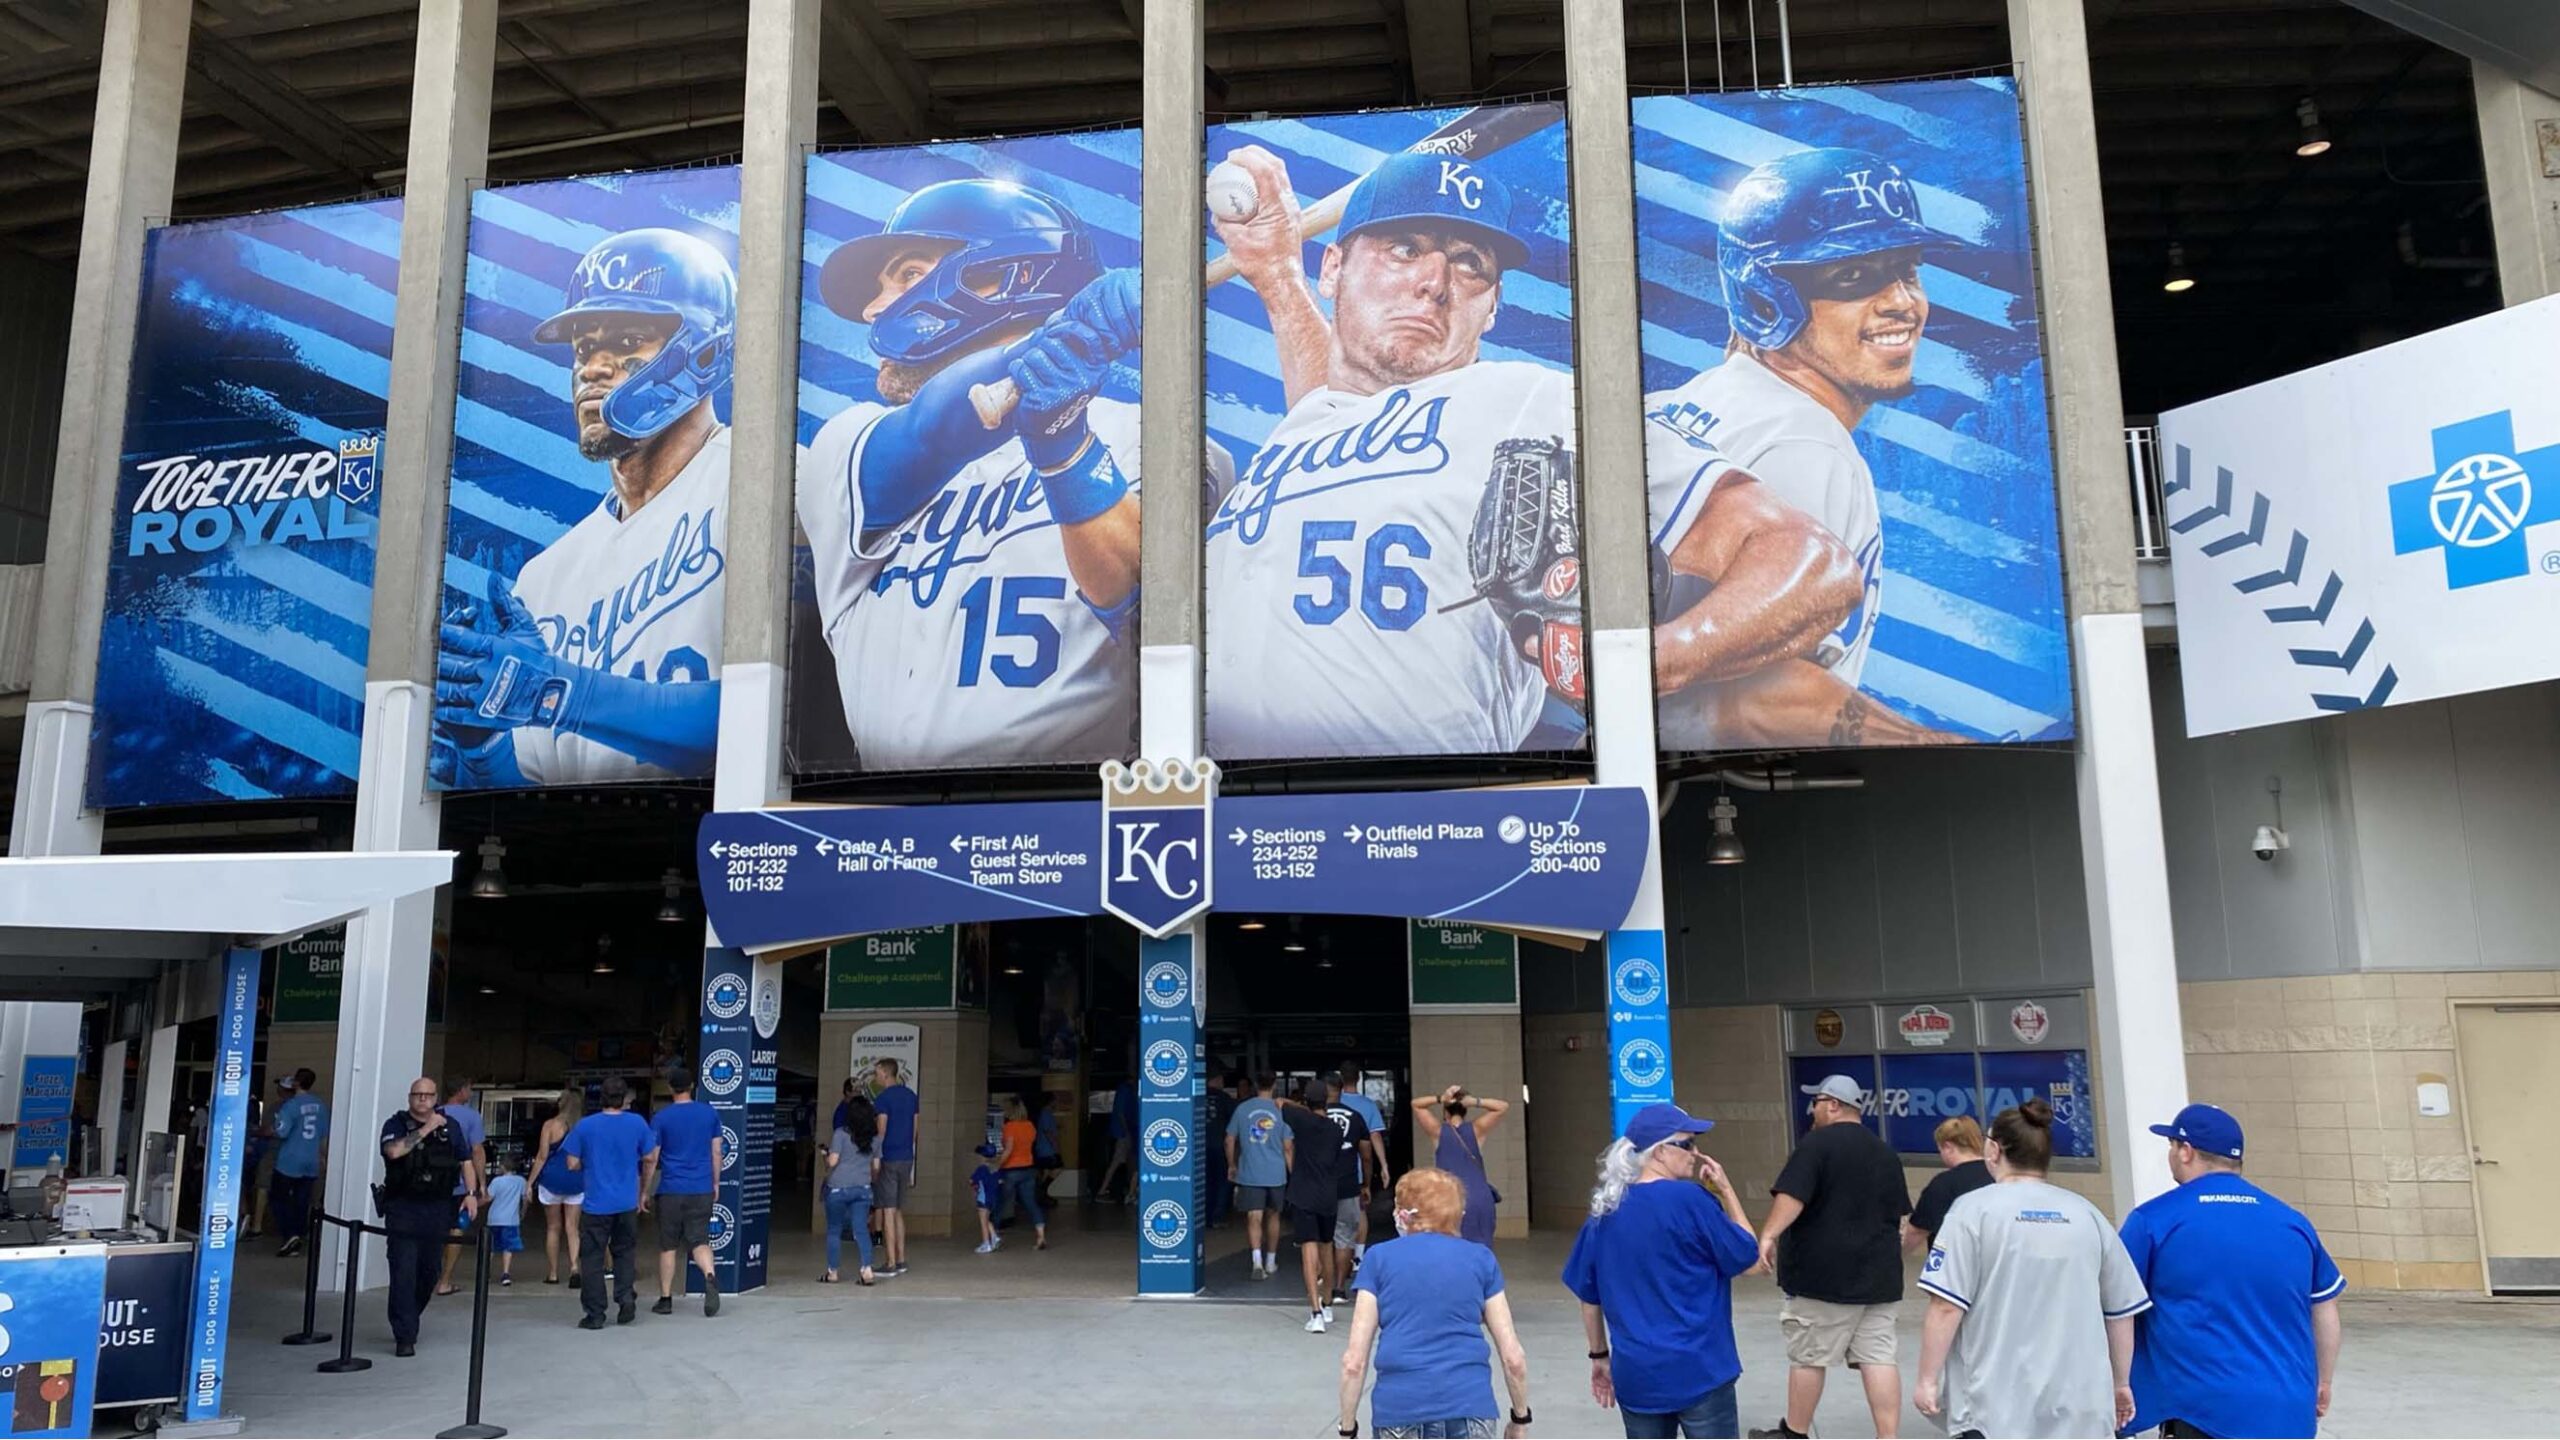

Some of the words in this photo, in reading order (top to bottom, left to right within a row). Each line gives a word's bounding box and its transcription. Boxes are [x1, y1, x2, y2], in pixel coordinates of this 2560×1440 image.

[1436, 160, 1484, 210] KC
[1845, 169, 1903, 217] KC
[582, 250, 629, 291] KC
[132, 450, 337, 514] TOGETHER
[342, 461, 371, 490] KC
[128, 495, 371, 557] ROYAL
[1293, 521, 1433, 632] 56
[957, 576, 1067, 688] 15
[1252, 828, 1326, 844] Sections
[1366, 825, 1433, 841] Outfield
[1438, 824, 1484, 840] Plaza
[1529, 822, 1554, 840] Up
[1558, 821, 1580, 837] To
[728, 843, 798, 858] Sections
[838, 840, 876, 855] Gate
[880, 839, 897, 855] A,
[902, 838, 915, 853] B
[971, 836, 1008, 851] First
[1011, 835, 1039, 850] Aid
[1367, 843, 1418, 859] Rivals
[1530, 840, 1607, 855] Sections
[970, 853, 1017, 868] Guest
[1020, 852, 1087, 867] Services
[1115, 822, 1198, 900] KC
[1252, 845, 1318, 862] 234-252
[727, 859, 788, 875] 201-232
[838, 857, 868, 872] Hall
[872, 856, 889, 870] of
[893, 856, 938, 870] Fame
[1253, 863, 1315, 879] 133-152
[1530, 856, 1601, 873] 300-400
[727, 876, 784, 892] 101-132
[970, 870, 1014, 885] Team
[1018, 869, 1063, 883] Store
[1441, 928, 1483, 944] Bank
[866, 937, 916, 957] Bank
[837, 973, 889, 984] Challenge
[235, 973, 247, 1010] HOUSE
[232, 1014, 243, 1039] DOG
[857, 1036, 894, 1044] STADIUM
[895, 1035, 914, 1043] MAP
[752, 1050, 777, 1064] LARRY
[224, 1049, 243, 1096] DUGOUT
[750, 1068, 778, 1082] HOLLEY
[302, 1116, 317, 1139] 5
[220, 1122, 233, 1160] HOUSE
[218, 1165, 229, 1189] DOG
[210, 1203, 230, 1249] DUGOUT
[209, 1276, 221, 1316] HOUSE
[100, 1328, 156, 1348] OUSE
[206, 1319, 217, 1345] DOG
[198, 1357, 217, 1407] DUGOUT
